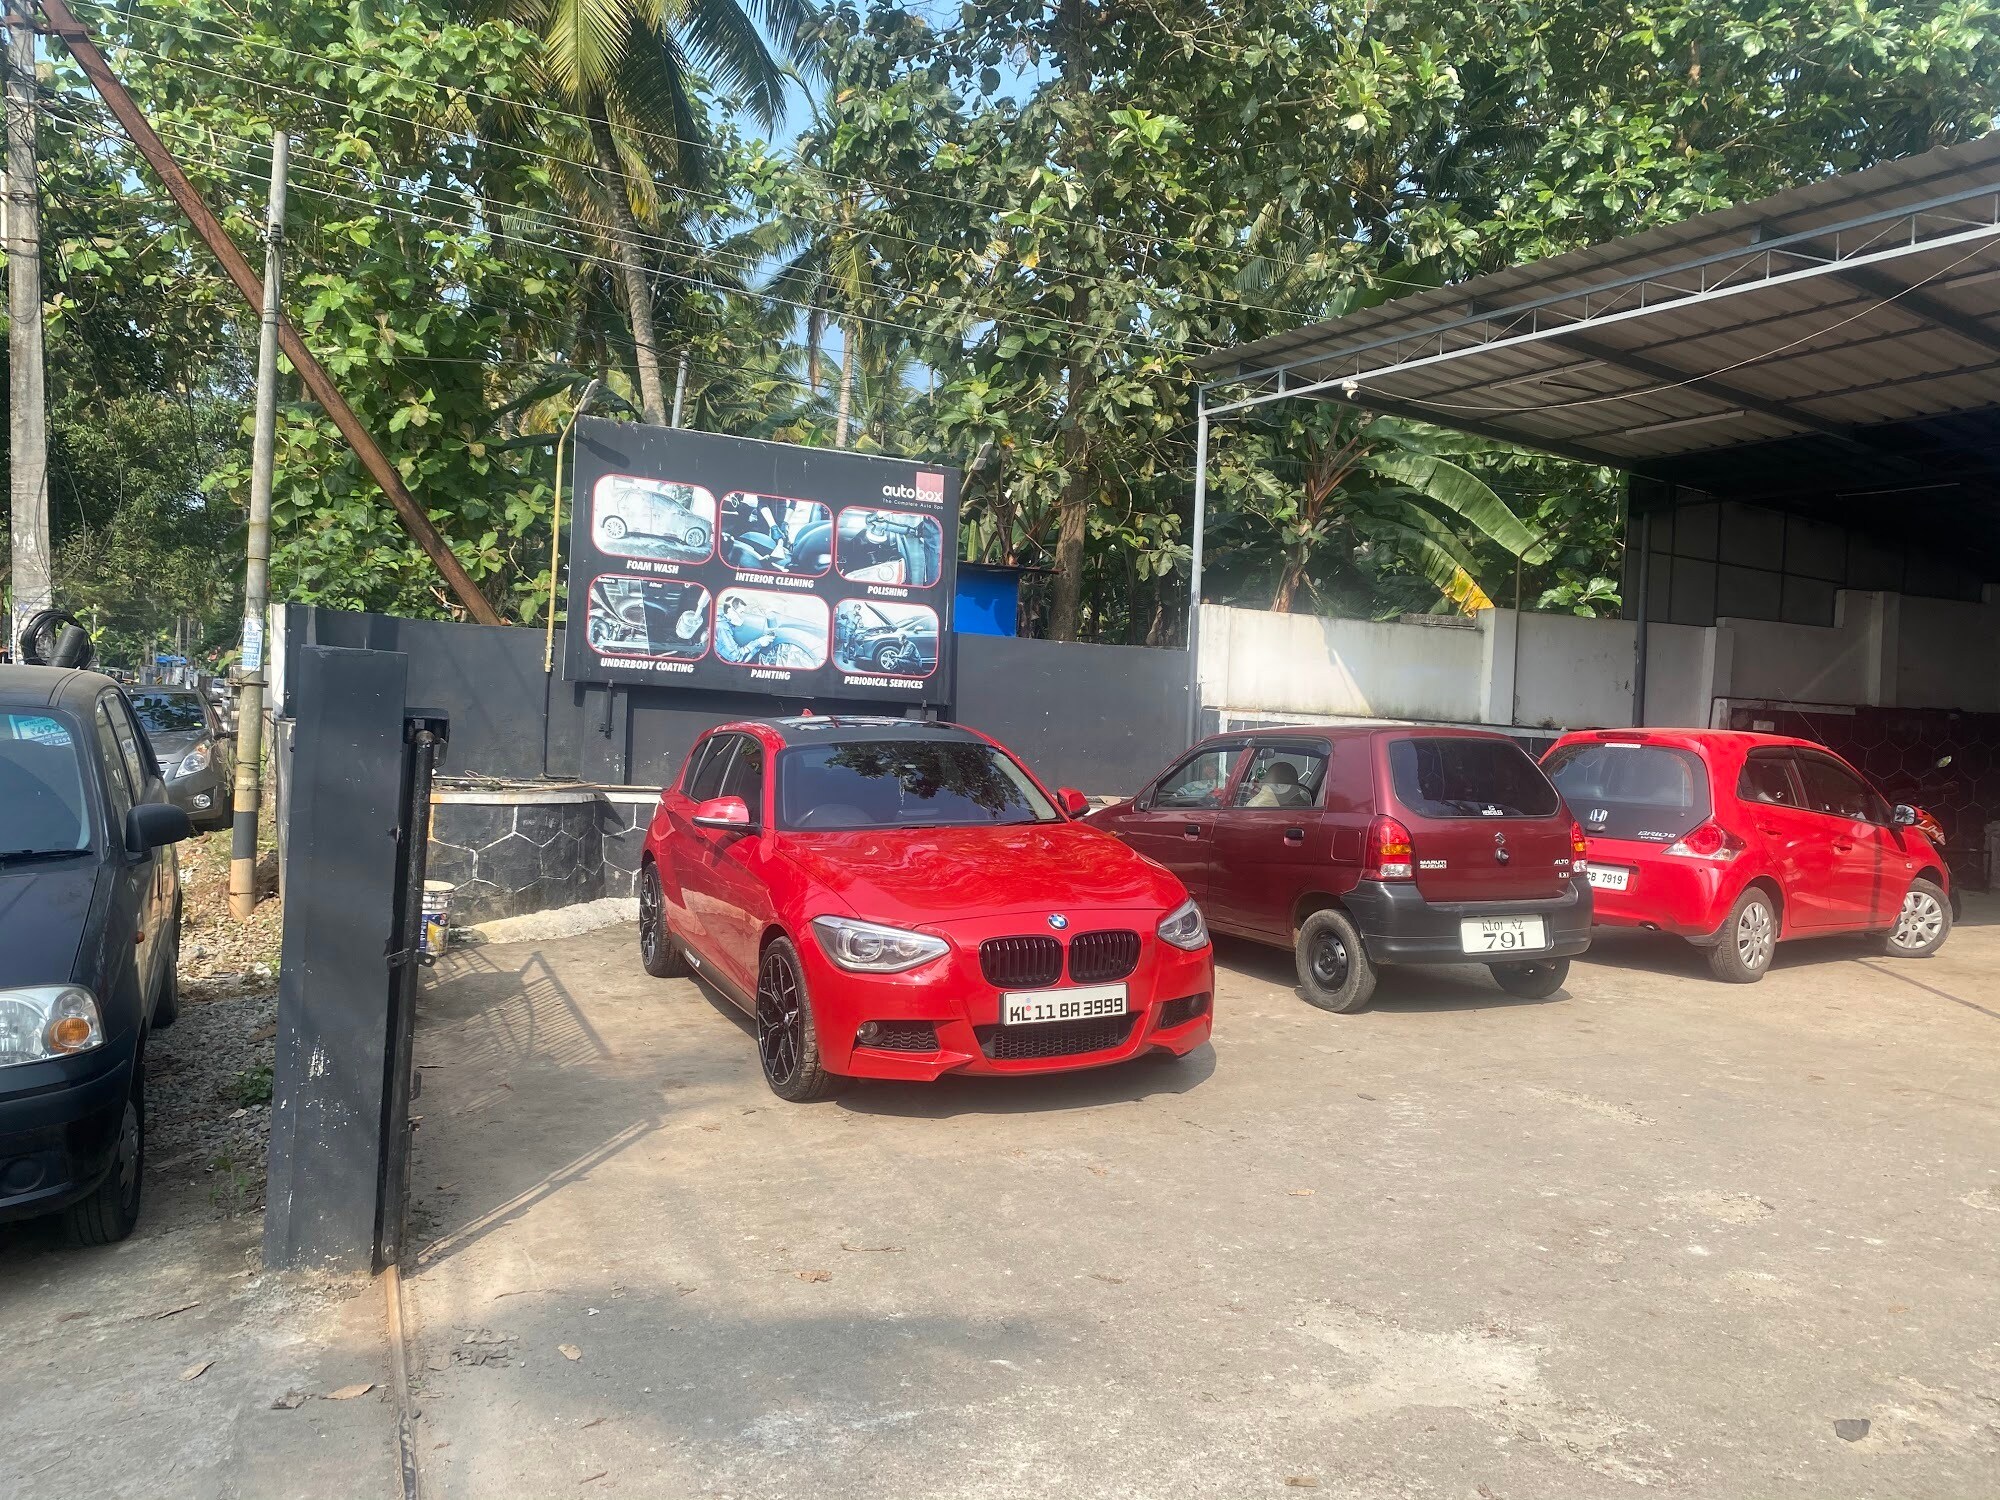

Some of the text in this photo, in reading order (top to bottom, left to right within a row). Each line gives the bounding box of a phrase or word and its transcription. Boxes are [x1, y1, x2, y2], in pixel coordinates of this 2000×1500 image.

[882, 483, 943, 503] autobox
[626, 560, 679, 575] FOAM WASH
[735, 572, 815, 589] INTERIOR CLEANING
[867, 585, 909, 598] POLISHING
[600, 657, 695, 674] UNDERBODY COATING
[750, 668, 791, 681] PAINTING
[843, 675, 924, 690] PERIODICAL SERVICES
[1554, 858, 1569, 866] ALTO
[1602, 873, 1623, 885] 7919
[1483, 931, 1525, 950] 791
[1010, 1006, 1031, 1021] KL
[1035, 1004, 1056, 1020] 11
[1083, 998, 1122, 1015] 3999
